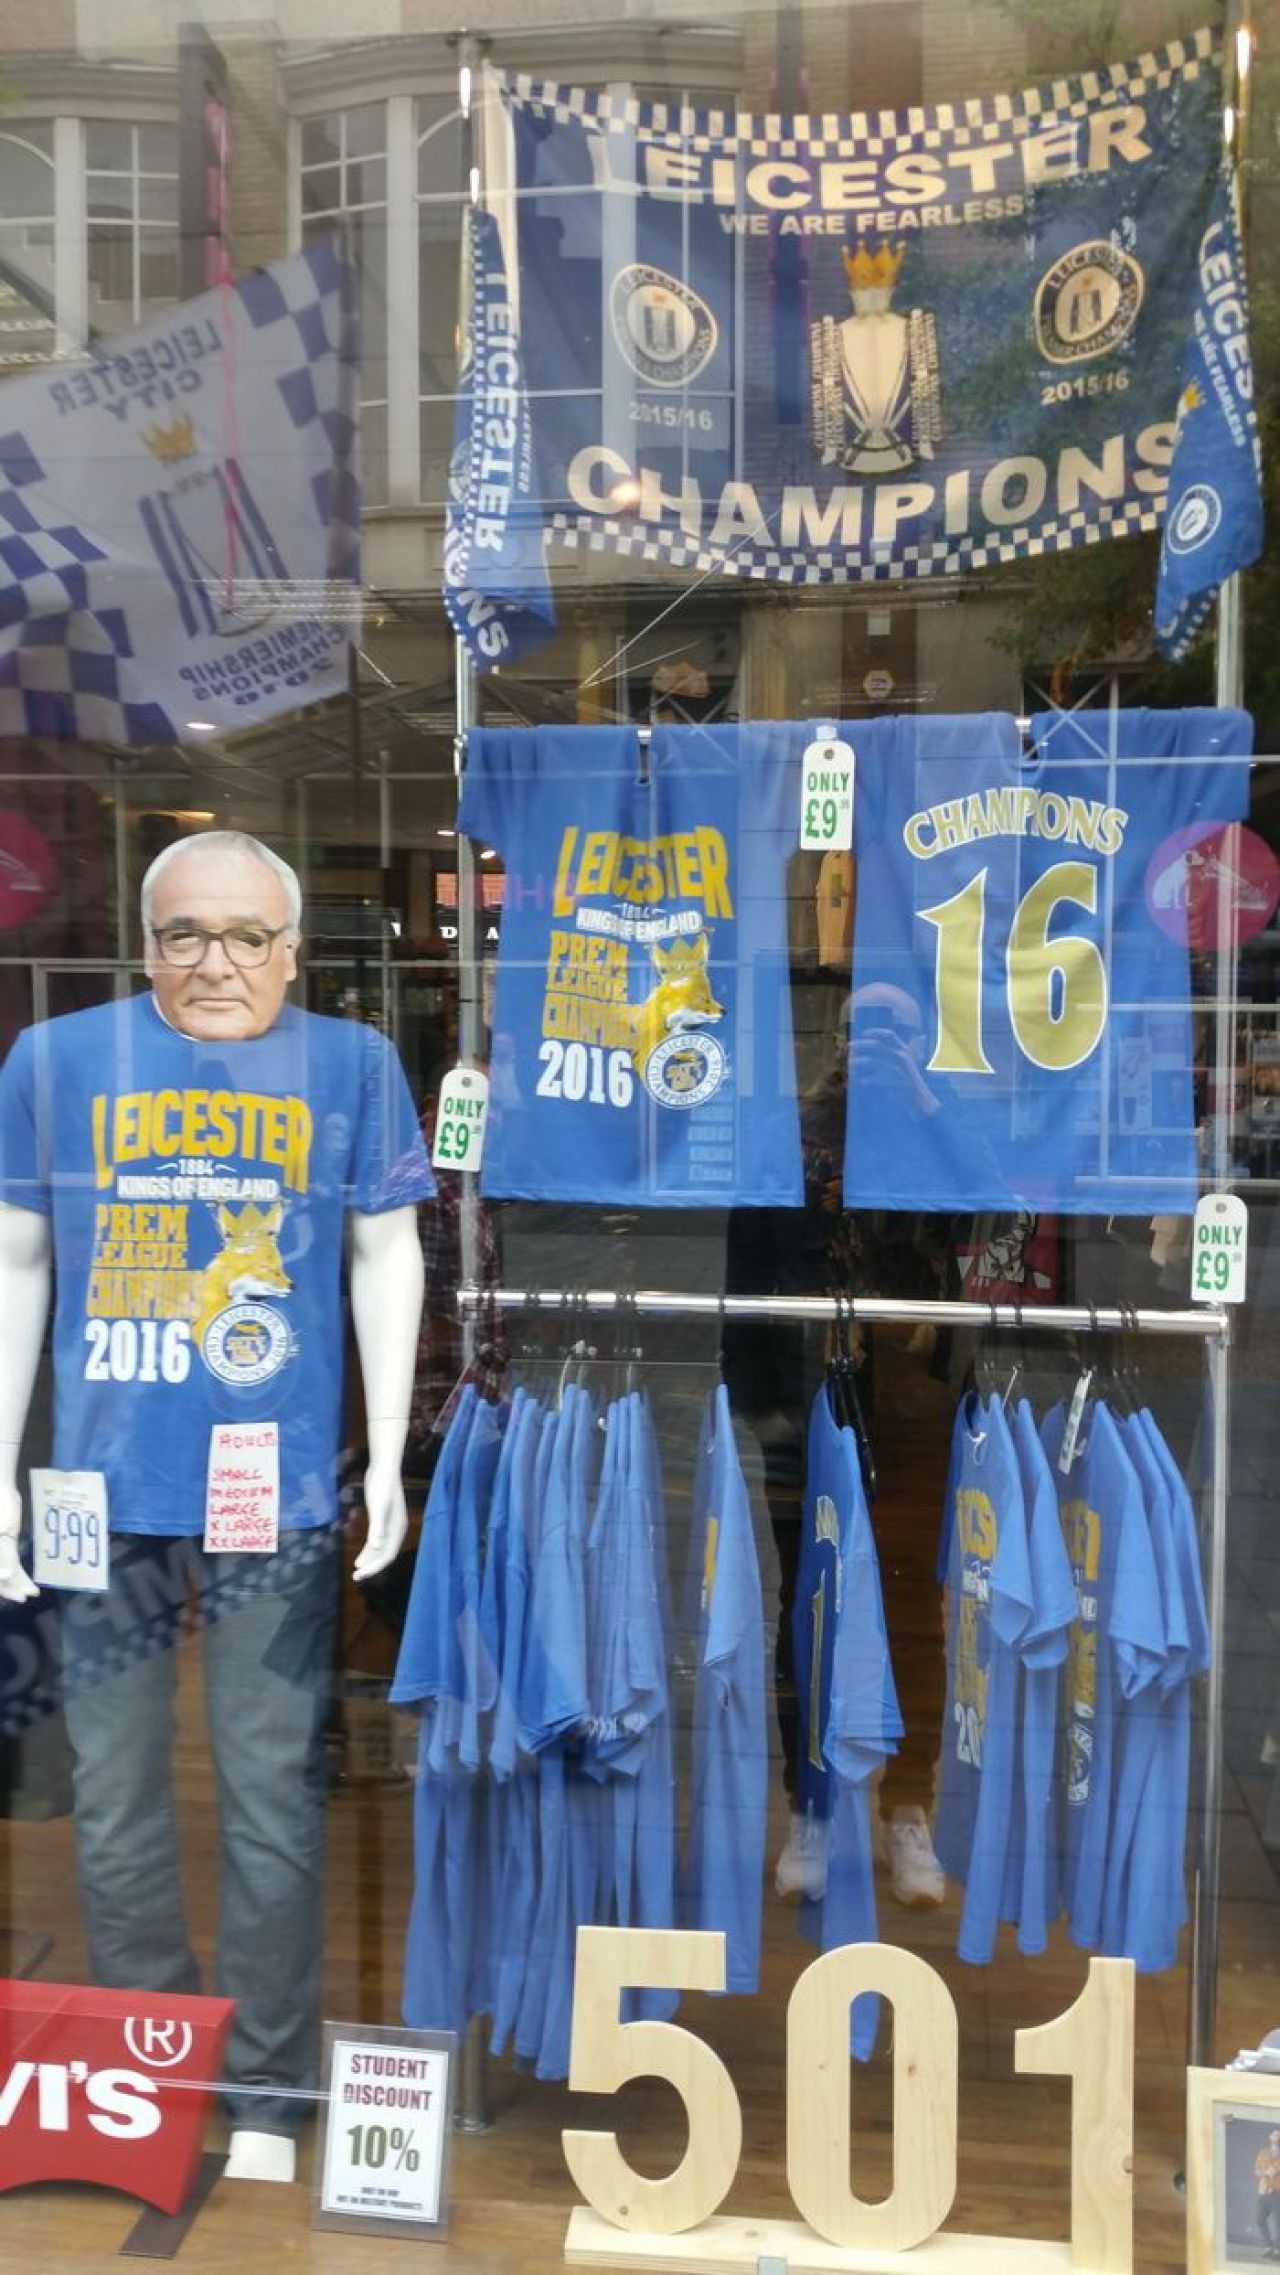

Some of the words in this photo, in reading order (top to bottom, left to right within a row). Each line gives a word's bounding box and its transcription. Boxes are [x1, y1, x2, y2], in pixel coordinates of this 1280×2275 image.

[588, 104, 1152, 212] LEICESTER
[719, 214, 770, 236] WE
[780, 213, 846, 235] ARE
[857, 196, 1025, 231] FEARLESS
[628, 401, 714, 431] 2015/16
[566, 422, 1179, 549] CHAMPIONS
[807, 772, 850, 792] ONLY
[903, 787, 1129, 860] CHAMPONS
[553, 825, 735, 919] LEICESTER
[550, 931, 629, 975] PREM
[915, 860, 1107, 1075] 16
[535, 1039, 634, 1108] 2016
[444, 1096, 485, 1118] ONLY
[92, 1089, 313, 1195] LEICESTER
[117, 1176, 171, 1200] KINGS
[172, 1177, 197, 1200] OF
[199, 1178, 280, 1201] ENGLAND
[95, 1203, 189, 1242] PREM
[1199, 1225, 1243, 1245] ONLY
[92, 1241, 189, 1269] LEAGUE
[84, 1318, 191, 1384] 2016
[351, 2053, 429, 2080] STUDENT
[343, 2082, 433, 2112] DISCOUNT
[561, 1925, 1135, 2272] 501
[346, 2124, 420, 2172] 10%
